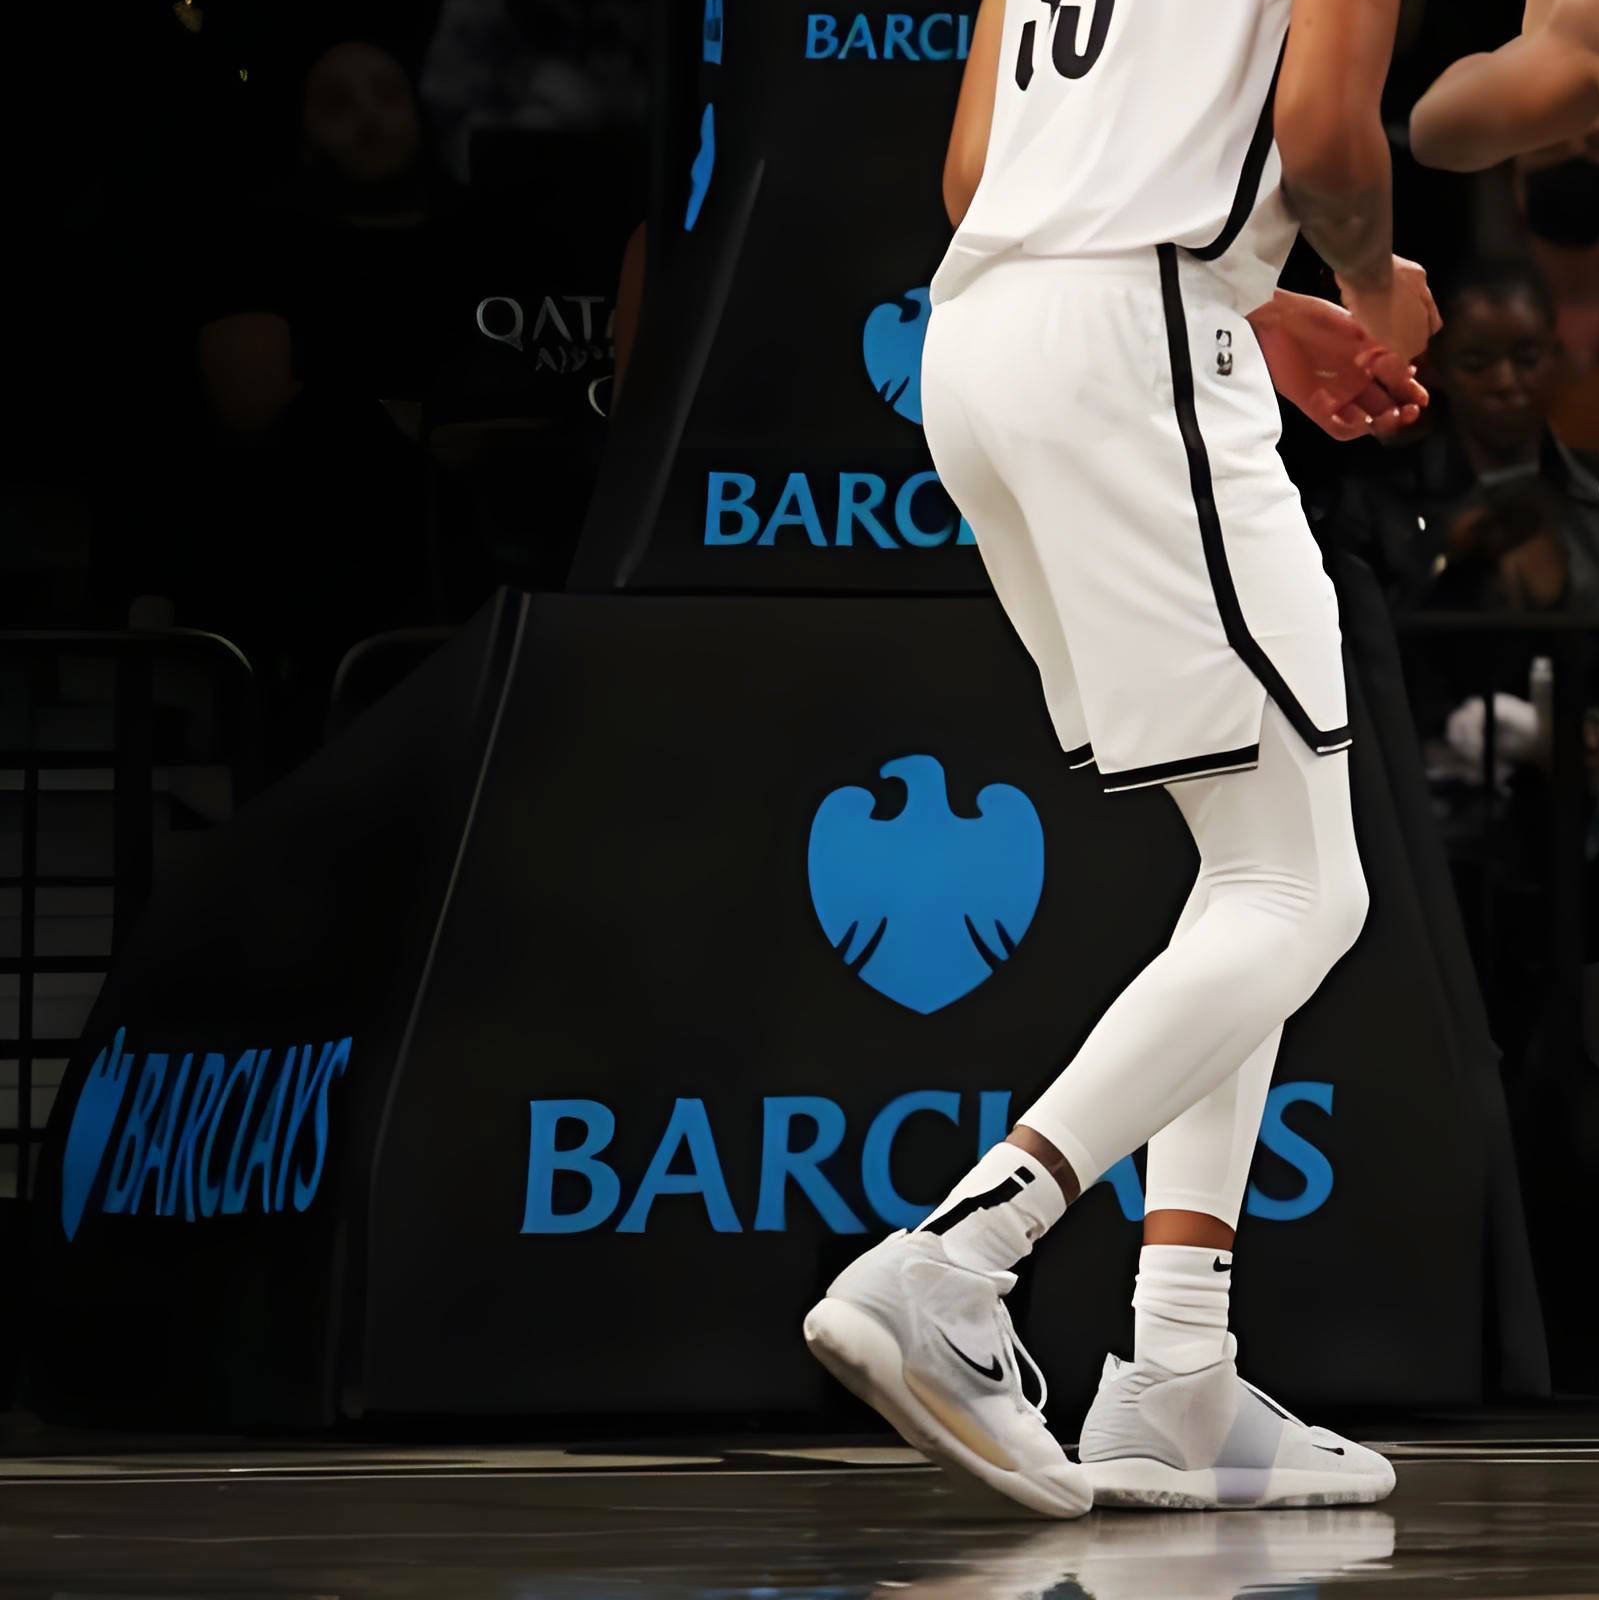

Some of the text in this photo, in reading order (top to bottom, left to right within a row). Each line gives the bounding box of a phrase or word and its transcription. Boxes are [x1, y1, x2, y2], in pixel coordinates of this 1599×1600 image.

[805, 13, 969, 61] BARCL
[476, 295, 616, 352] QAT
[703, 471, 977, 548] BARC
[102, 1036, 352, 1223] BARCLAYS
[520, 1081, 1334, 1234] BARCS
